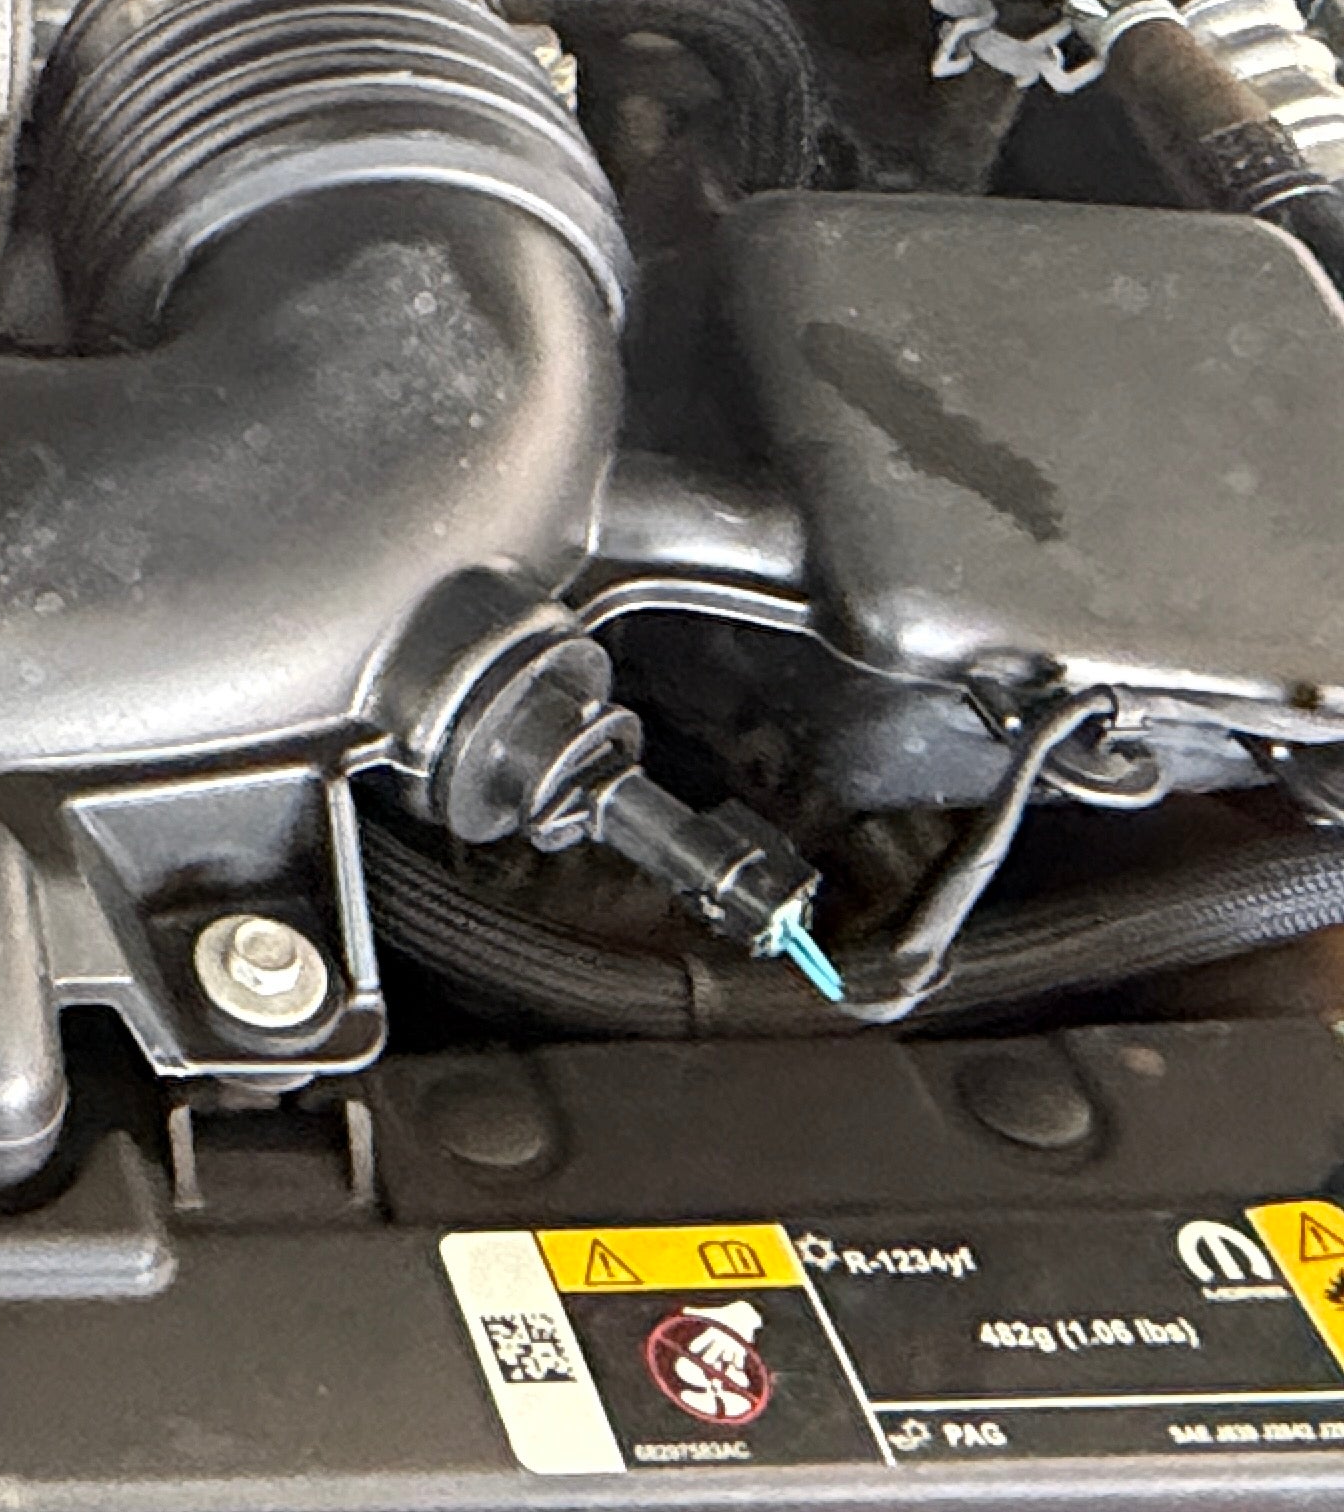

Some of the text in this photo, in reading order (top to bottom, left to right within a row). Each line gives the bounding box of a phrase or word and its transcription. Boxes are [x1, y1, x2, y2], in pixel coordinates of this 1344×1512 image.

[980, 1316, 1200, 1353] 482g (1.06 lbs)
[942, 1423, 1008, 1448] PAG
